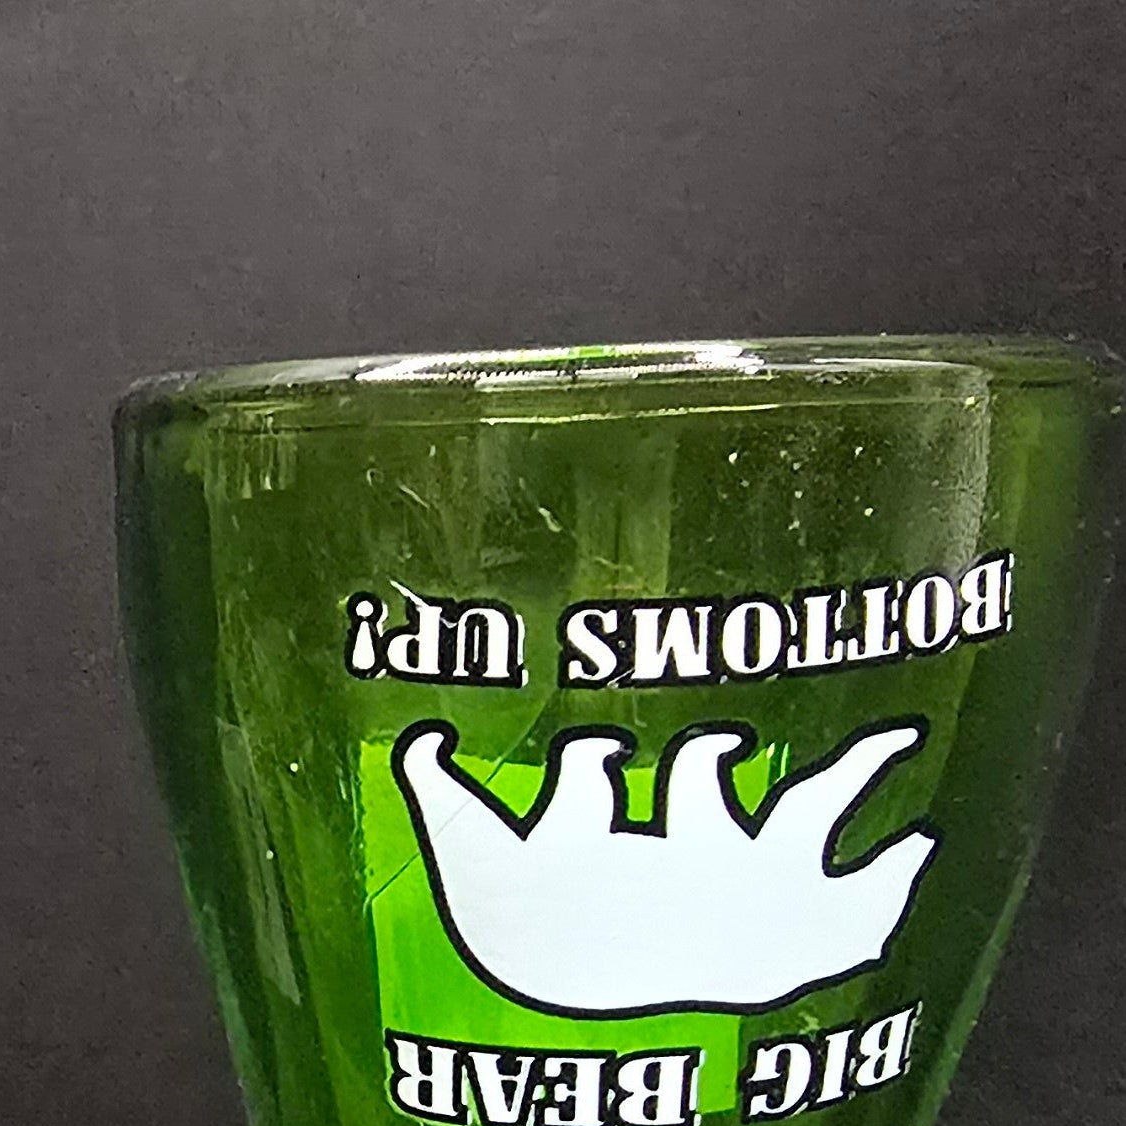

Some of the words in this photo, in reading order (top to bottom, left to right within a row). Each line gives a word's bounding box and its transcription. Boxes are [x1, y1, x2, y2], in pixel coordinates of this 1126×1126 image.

[349, 594, 525, 684] UP!
[564, 554, 1013, 684] BOTTOMS
[746, 1003, 920, 1120] BIG
